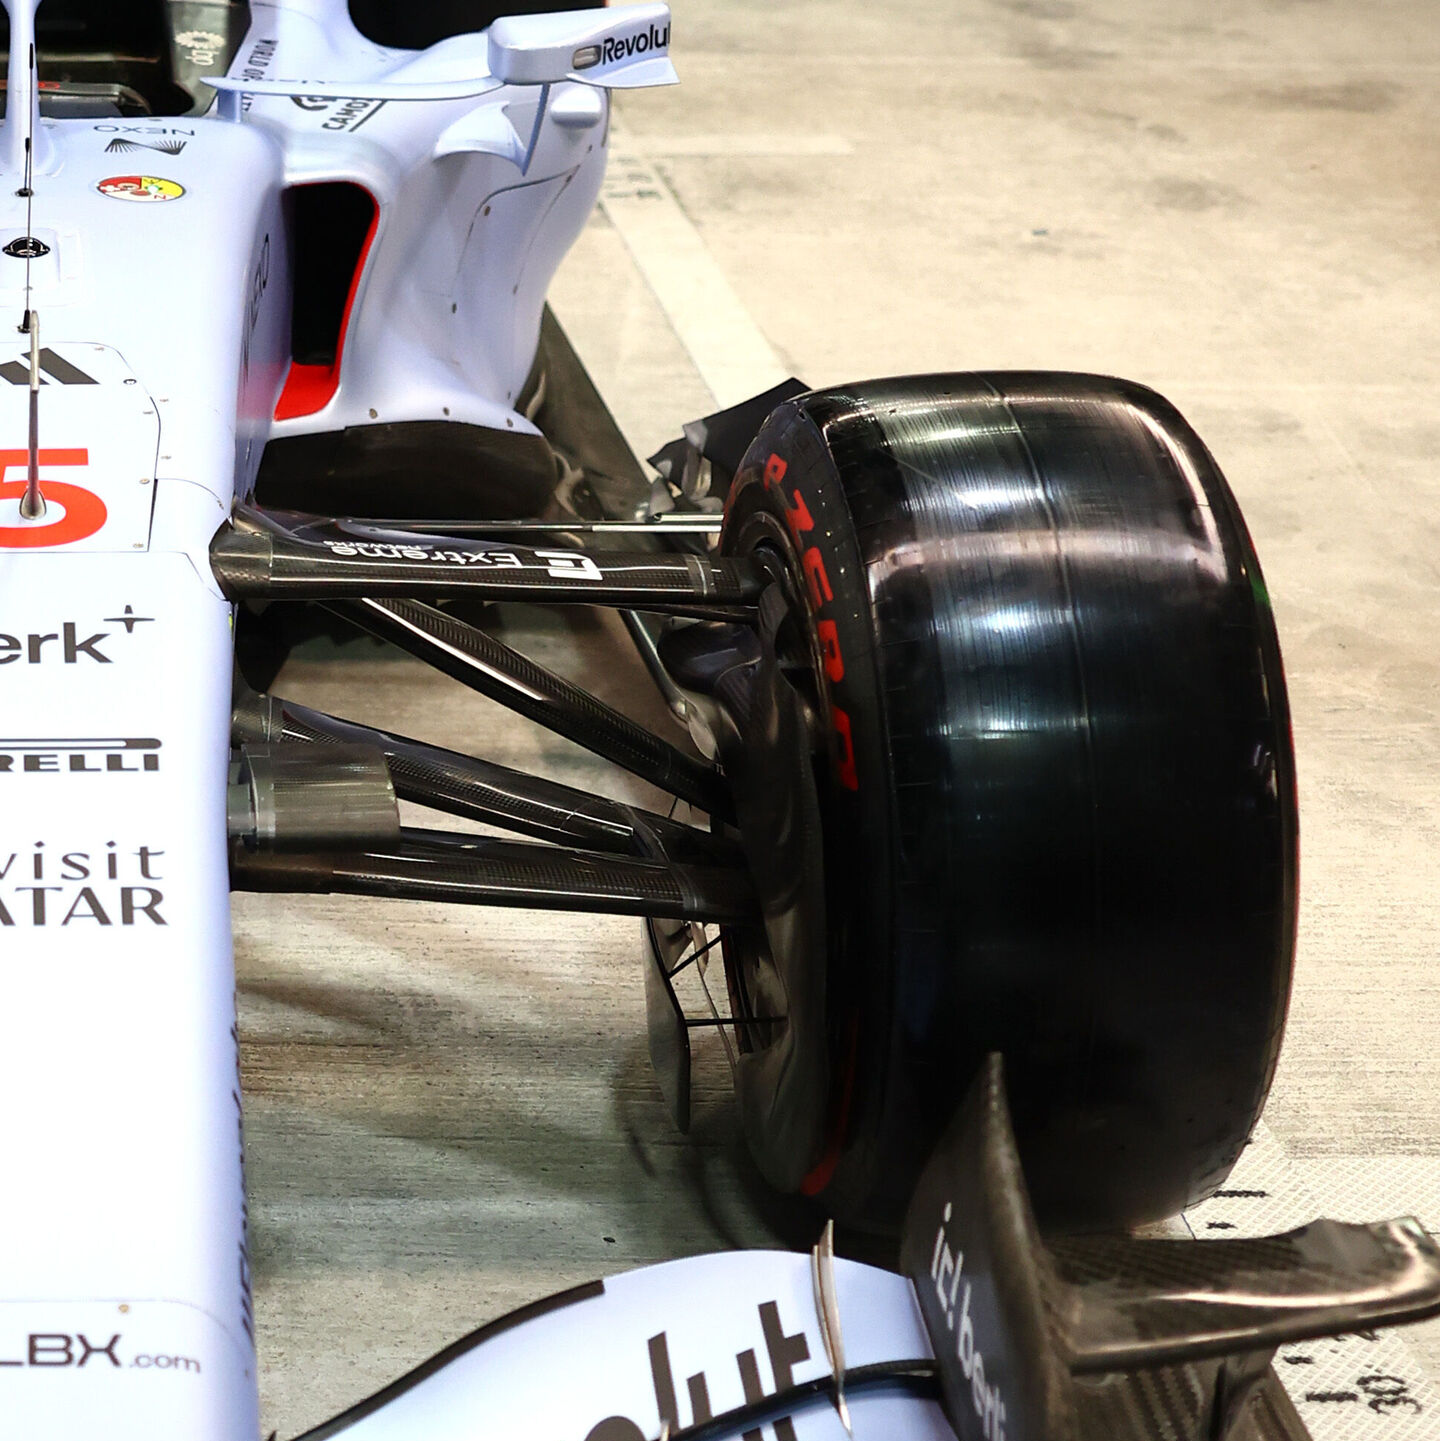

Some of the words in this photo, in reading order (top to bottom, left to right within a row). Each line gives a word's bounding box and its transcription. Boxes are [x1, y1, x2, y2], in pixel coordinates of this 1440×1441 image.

[185, 49, 220, 67] bp
[248, 38, 279, 66] WORLD
[321, 99, 371, 131] CAMO
[94, 124, 196, 137] NEXO
[332, 546, 519, 569] Extreme
